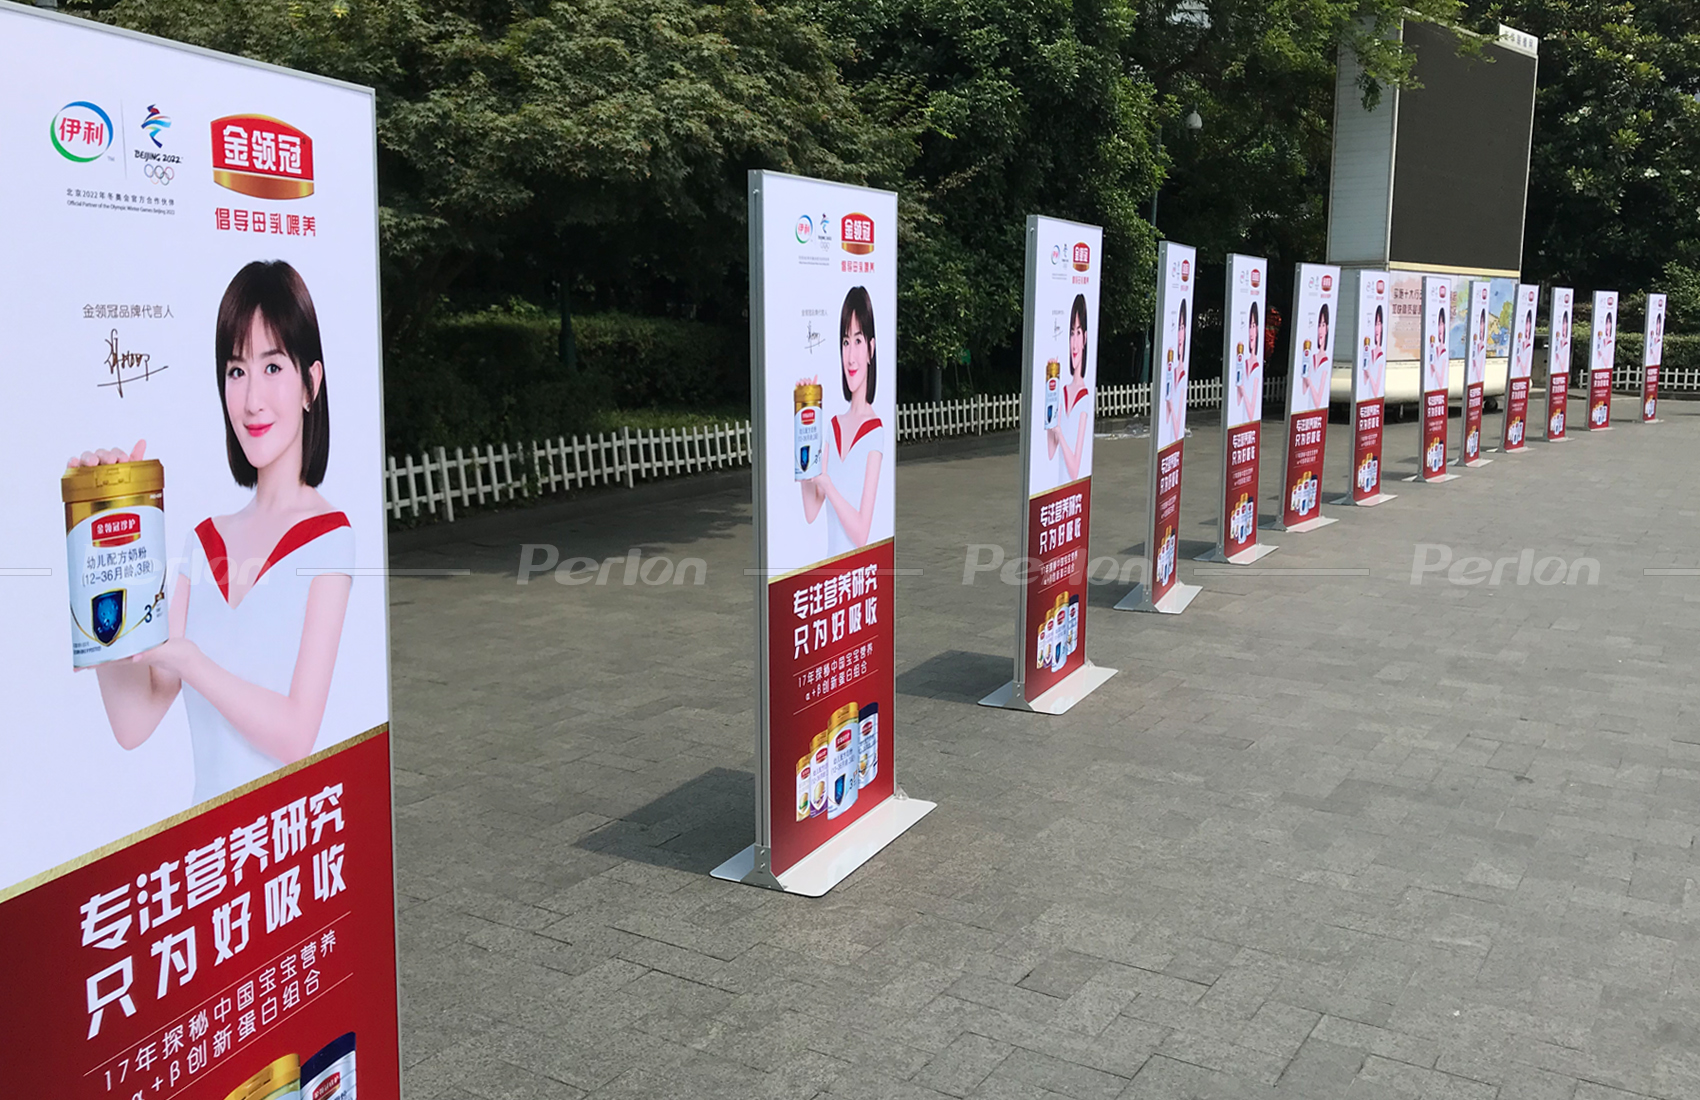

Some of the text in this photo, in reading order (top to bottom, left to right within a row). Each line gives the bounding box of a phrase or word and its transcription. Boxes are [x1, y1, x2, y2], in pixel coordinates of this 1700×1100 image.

[59, 117, 104, 146] 伊利
[222, 125, 302, 174] 金领冠
[134, 149, 182, 164] BEIJING 2022
[215, 207, 316, 237] 倡导母乳喂养
[844, 218, 871, 241] 金领冠
[82, 304, 174, 319] 金领冠品牌代言人
[87, 546, 147, 570] 幼儿配方奶粉
[793, 563, 878, 620] 专注营养研究
[794, 597, 878, 660] 只为好吸收
[80, 783, 345, 950] 专注营养研究
[86, 843, 348, 1040] 只为好吸收
[104, 929, 338, 1091] 17年探秘中国宝宝营养
